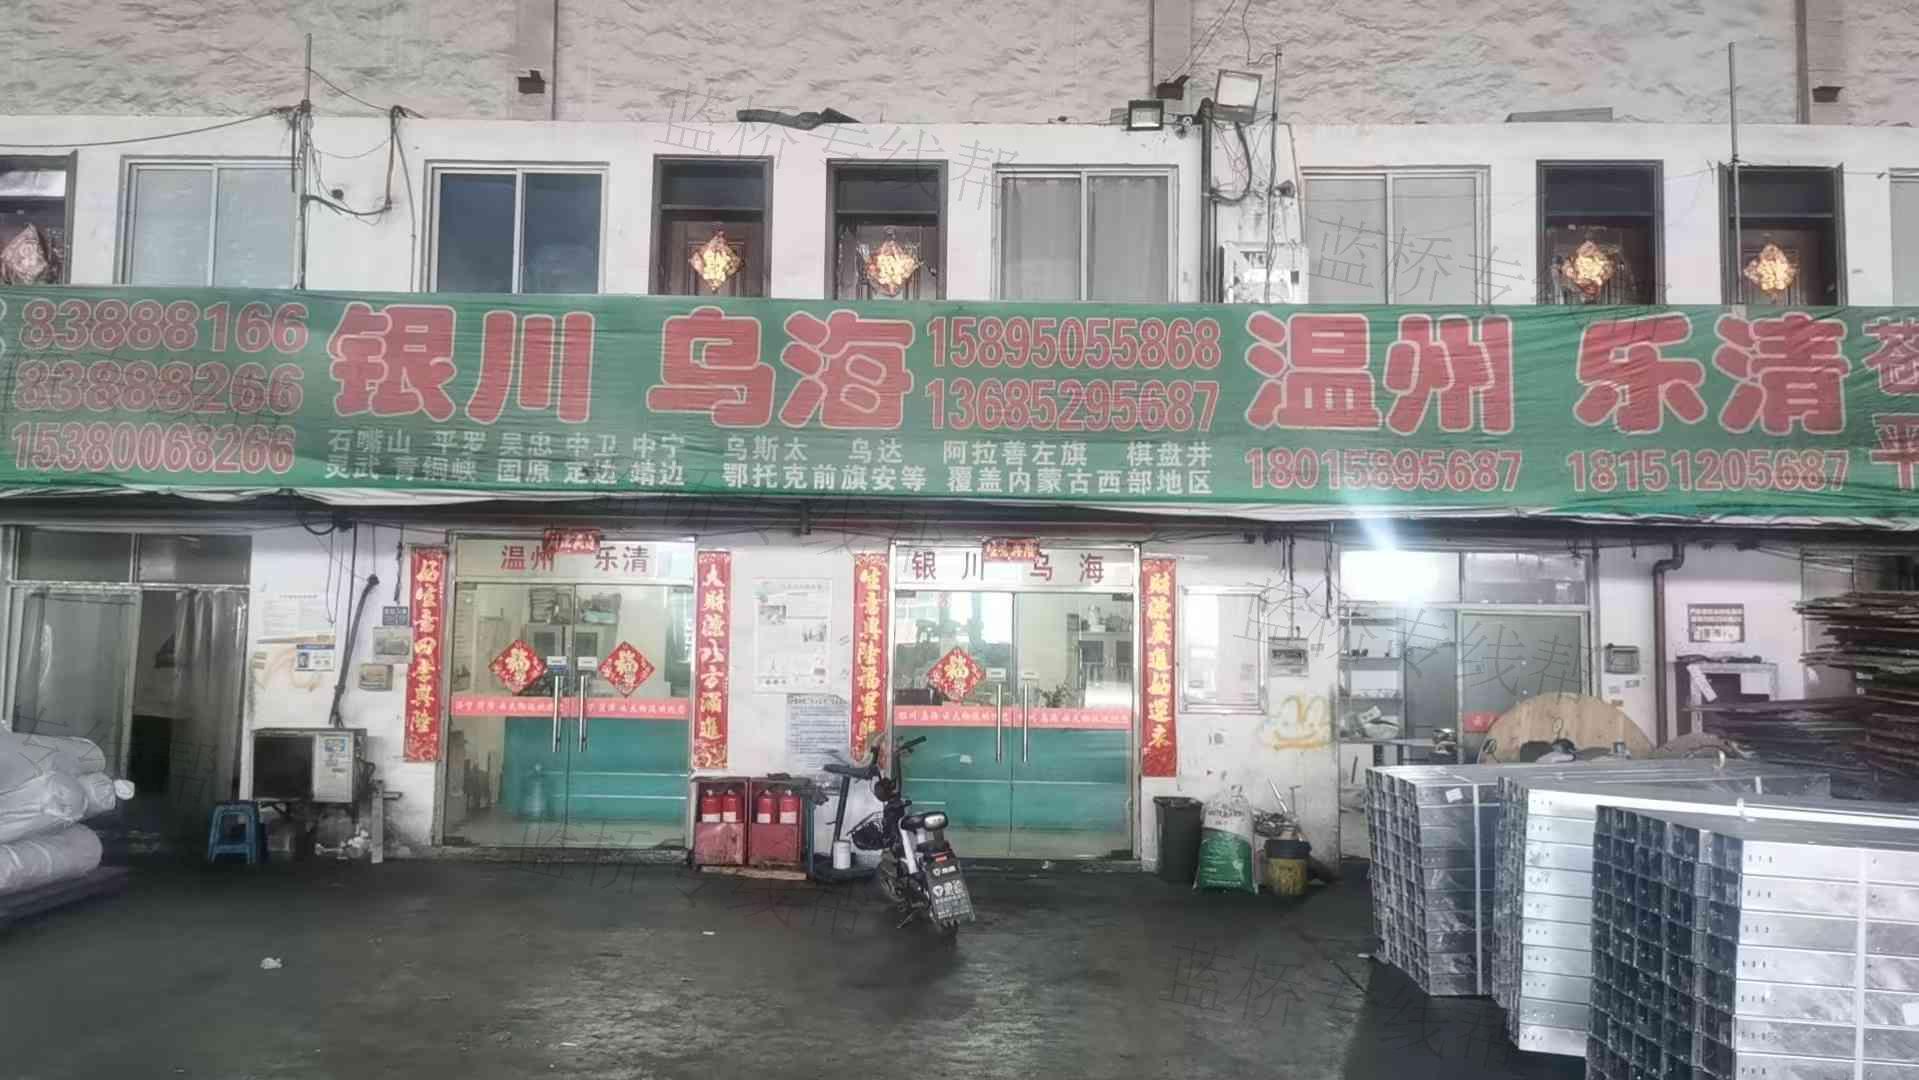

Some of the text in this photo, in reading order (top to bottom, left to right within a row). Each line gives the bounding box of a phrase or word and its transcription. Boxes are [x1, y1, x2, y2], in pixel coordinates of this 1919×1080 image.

[20, 298, 309, 353] 83888166
[926, 316, 1221, 370] 15895055868
[13, 360, 304, 415] 83888266
[330, 302, 916, 429] 银川 乌海
[1245, 311, 1852, 436] 温州 乐清
[926, 377, 1220, 432] 13685295687
[11, 422, 296, 474] 15380068266
[327, 429, 685, 459] 石嘴山 平罗 吴忠 中卫 中宁
[725, 436, 903, 463] 乌斯太 乌达
[943, 440, 1213, 468] 阿拉善左旗 棋盘井
[496, 458, 552, 483] 固原
[629, 460, 685, 487] 靖边
[722, 462, 928, 493] 鄂托克前旗安等
[946, 466, 1214, 496] 覆盖内蒙古西部地区
[1245, 448, 1521, 492] 18015895687
[1566, 448, 1849, 492] 18151205687
[501, 545, 649, 573] 温州 乐清
[911, 551, 1105, 583] 银川 乌海
